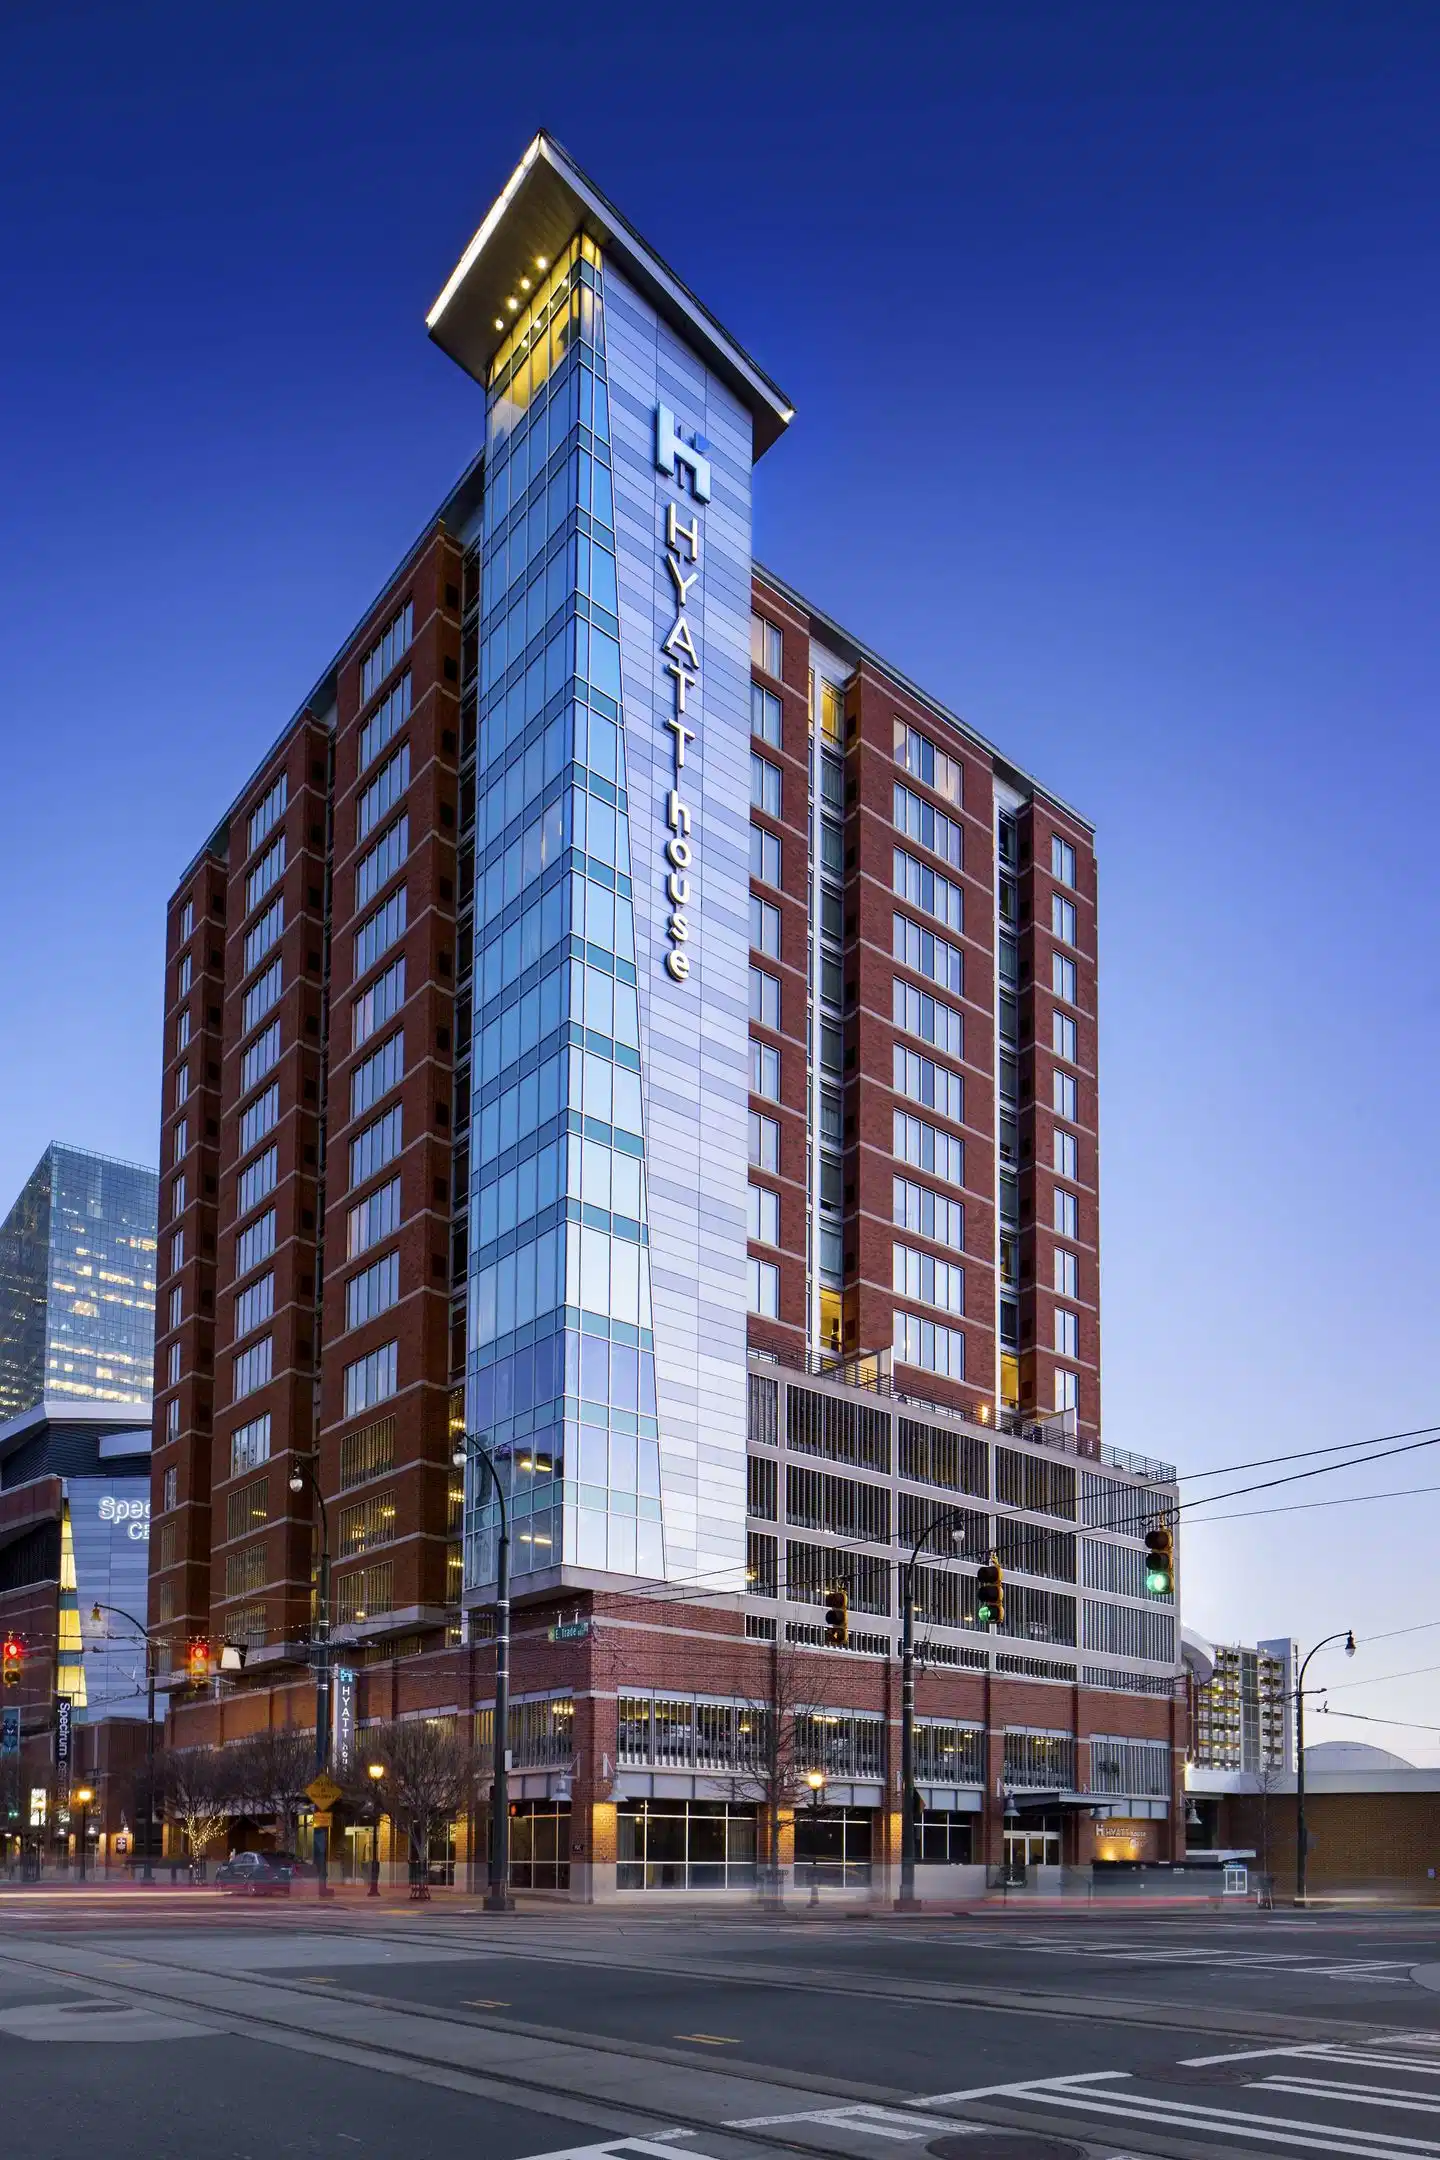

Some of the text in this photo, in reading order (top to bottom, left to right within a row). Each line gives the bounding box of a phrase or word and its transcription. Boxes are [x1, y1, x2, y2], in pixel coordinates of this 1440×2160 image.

[662, 501, 700, 981] HYATT house
[57, 1702, 71, 1756] Spectrum
[342, 1686, 351, 1738] HYATT
[1105, 1827, 1130, 1837] HYATT
